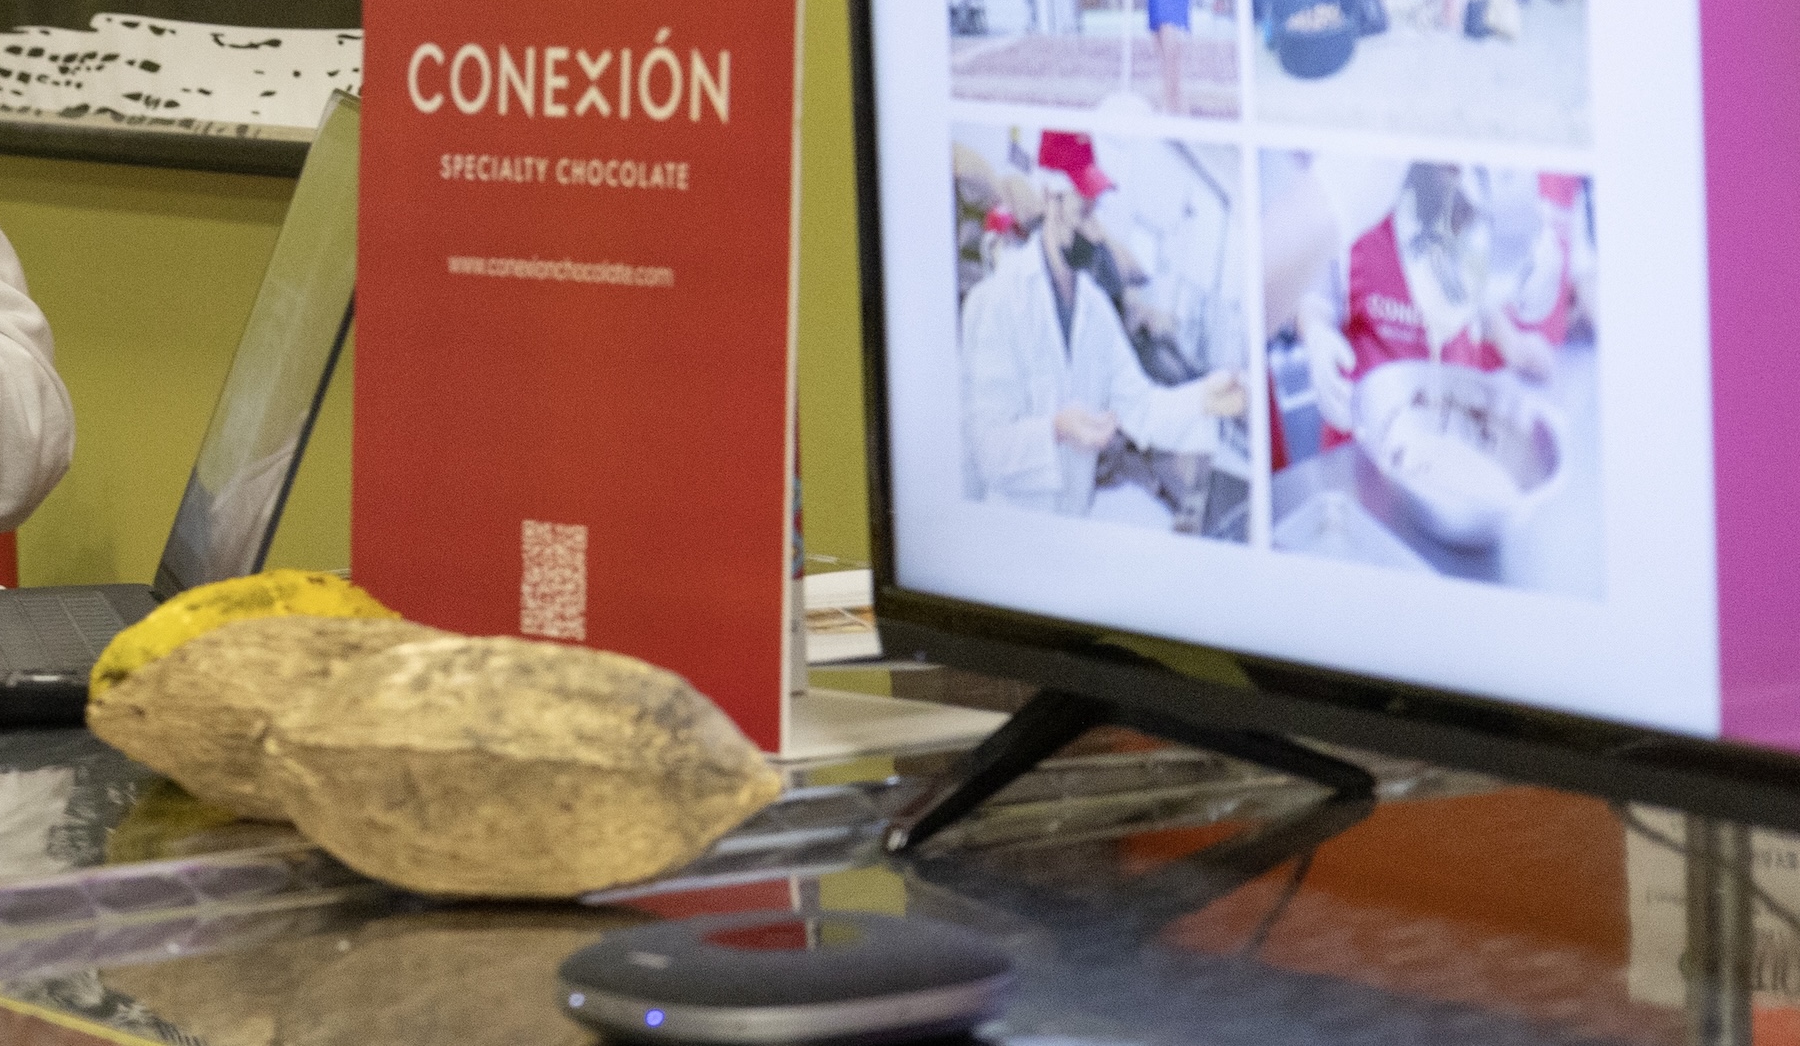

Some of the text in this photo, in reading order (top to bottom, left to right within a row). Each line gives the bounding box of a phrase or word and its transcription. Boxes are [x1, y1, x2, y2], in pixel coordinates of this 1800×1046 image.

[407, 27, 730, 123] CONEXIÓN
[440, 154, 690, 190] SPECIALTY CHOCOLATE
